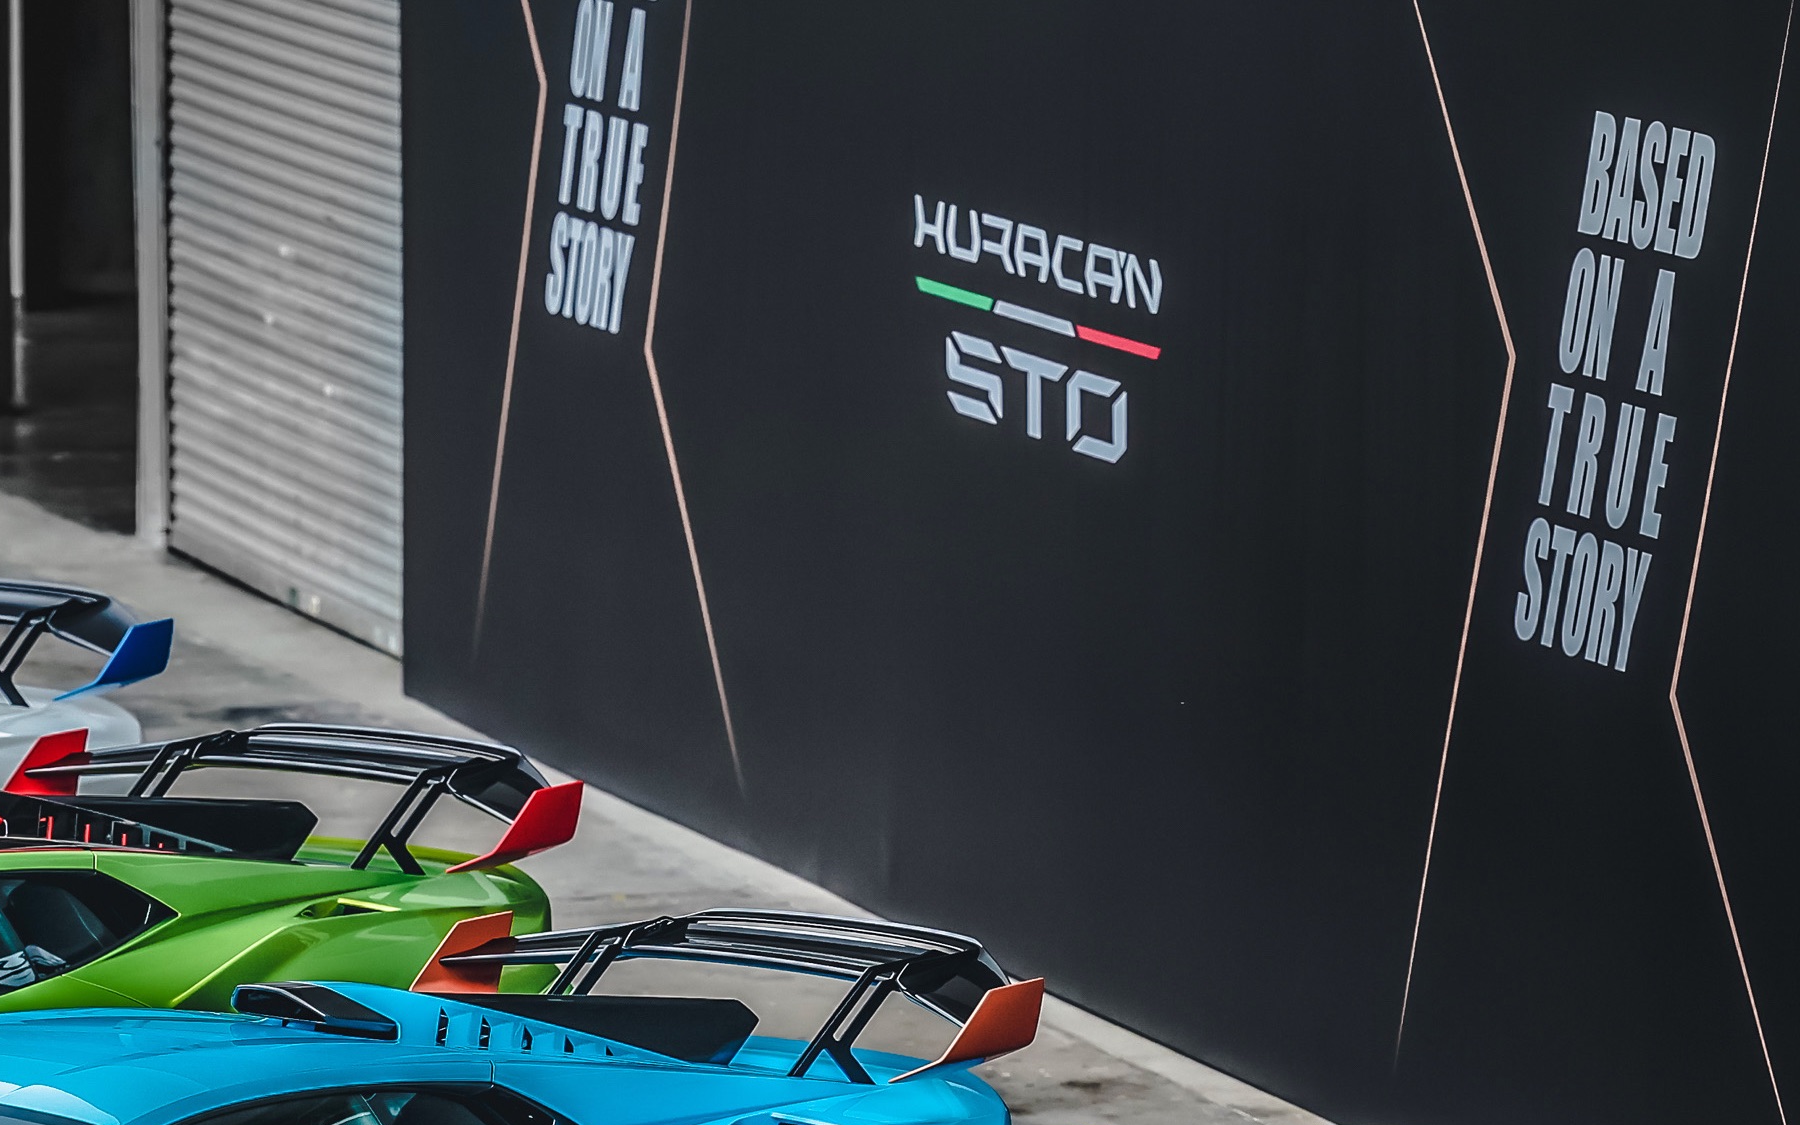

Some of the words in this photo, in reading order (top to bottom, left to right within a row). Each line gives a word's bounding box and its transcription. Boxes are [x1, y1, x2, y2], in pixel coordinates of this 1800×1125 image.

[570, 0, 613, 102] ON
[618, 8, 646, 111] A
[558, 103, 648, 226] TRUE
[1578, 111, 1716, 259] BASED
[545, 211, 635, 334] STORY
[1559, 248, 1624, 381] ON
[1636, 269, 1676, 396] A
[945, 331, 1128, 463] STO
[1539, 383, 1677, 539] TRUE
[1514, 518, 1652, 672] STORY
